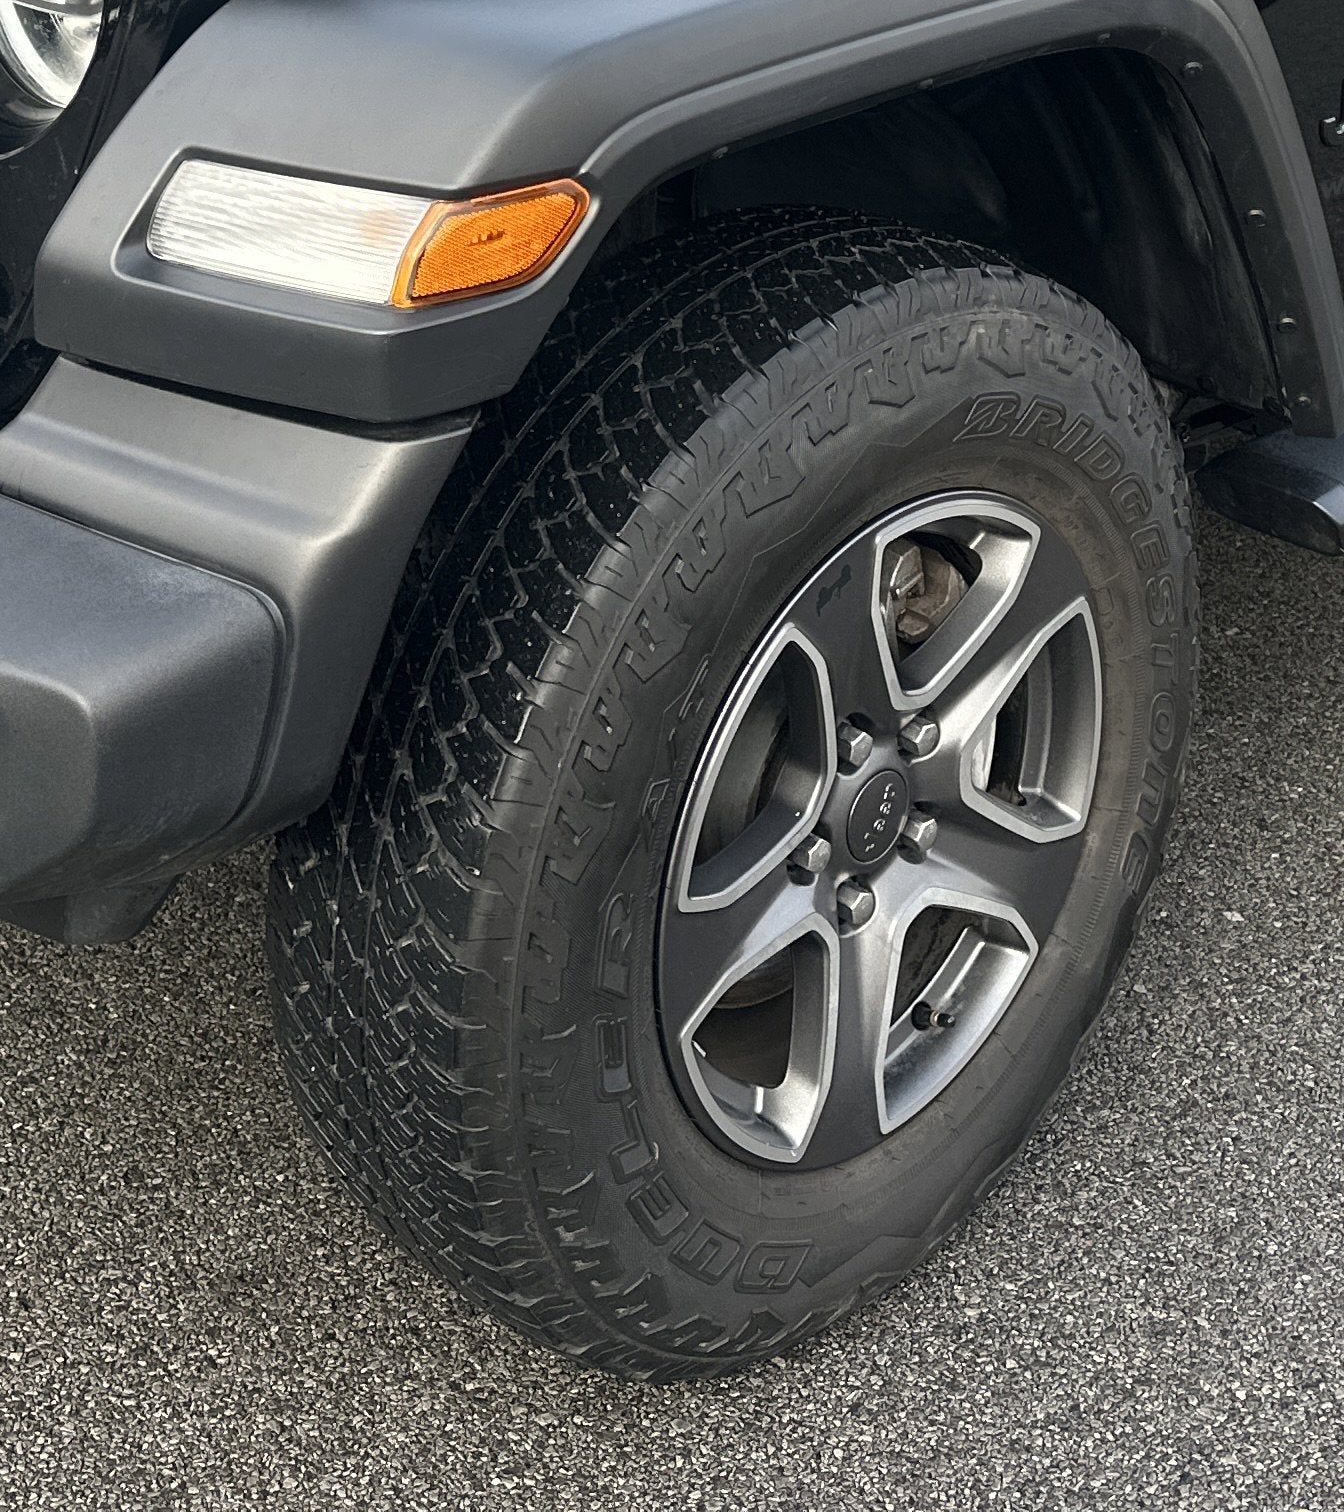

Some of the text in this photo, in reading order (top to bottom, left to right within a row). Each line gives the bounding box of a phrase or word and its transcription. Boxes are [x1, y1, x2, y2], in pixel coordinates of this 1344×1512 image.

[863, 782, 898, 853] Jeep
[953, 391, 1177, 896] BRIDGESTONE
[594, 890, 814, 1296] DUELER
